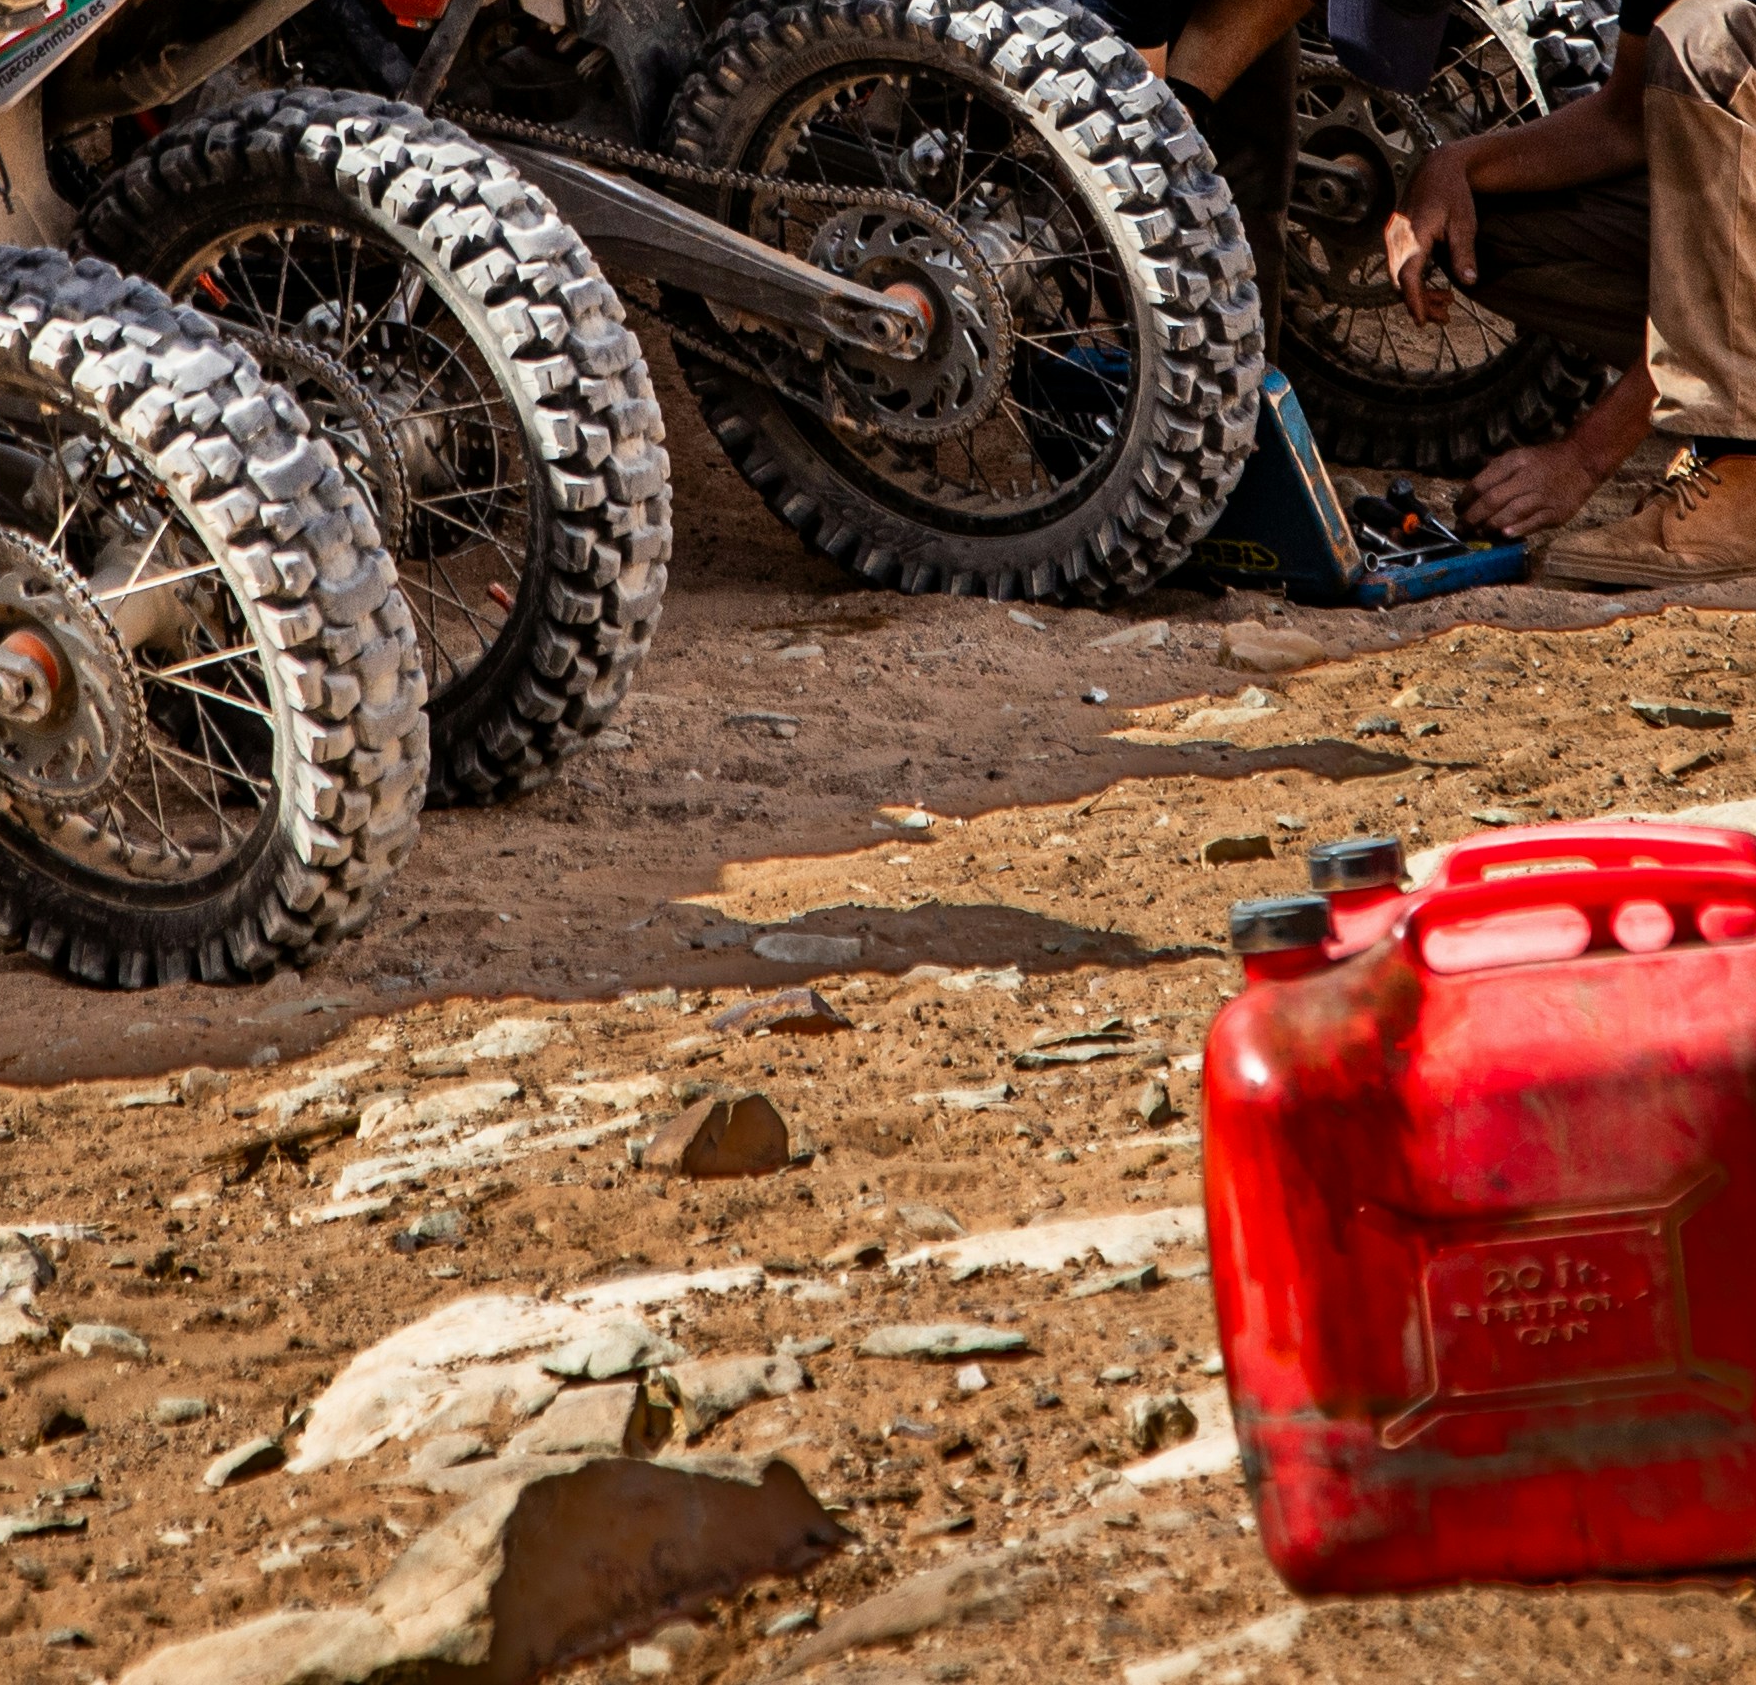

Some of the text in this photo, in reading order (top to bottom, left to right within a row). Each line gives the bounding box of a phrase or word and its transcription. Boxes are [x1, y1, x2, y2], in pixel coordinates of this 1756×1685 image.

[1485, 1258, 1544, 1296] 20
[1478, 1292, 1624, 1326] PETROL
[1515, 1319, 1590, 1346] CAN
